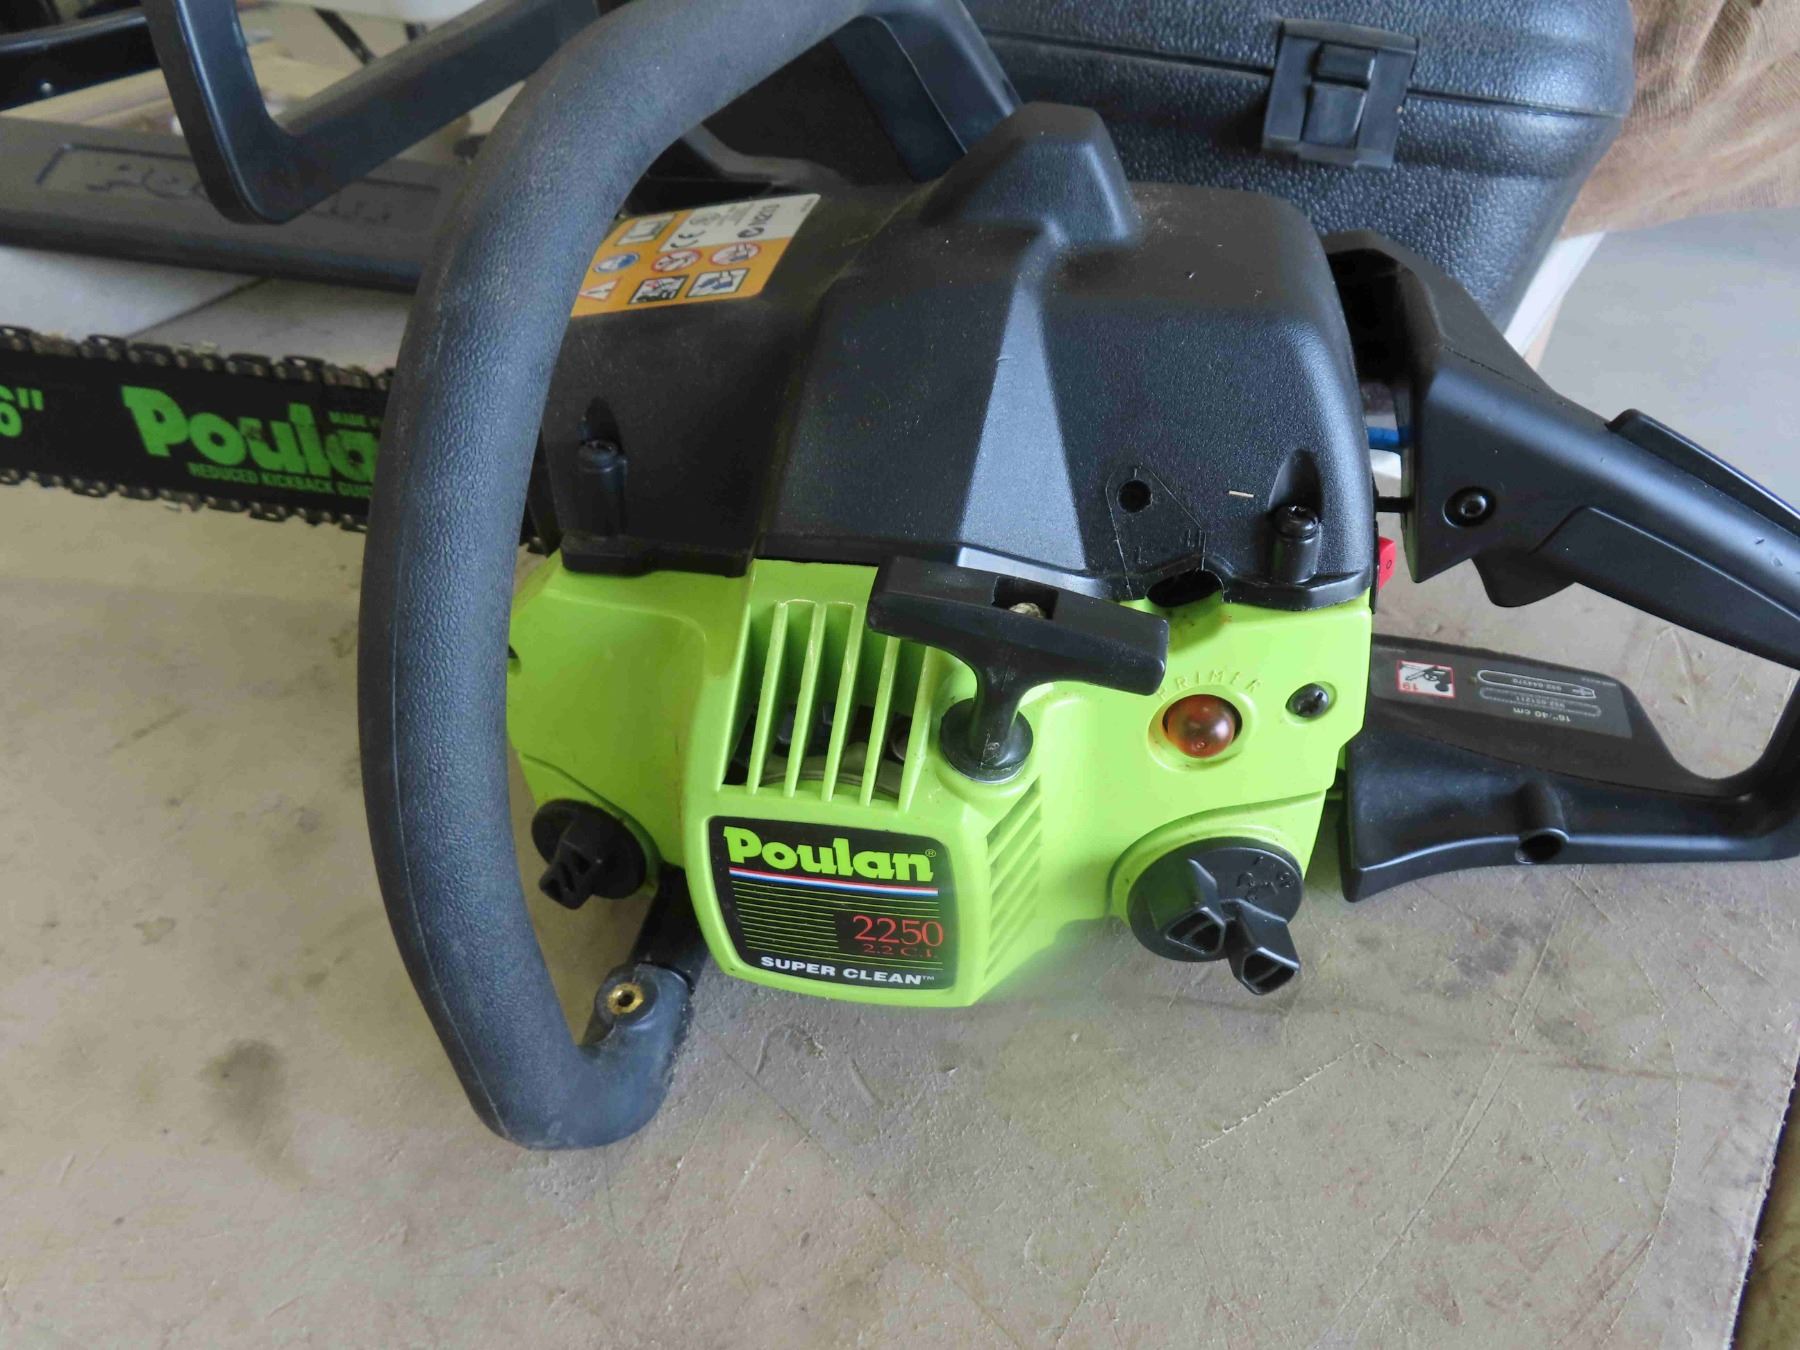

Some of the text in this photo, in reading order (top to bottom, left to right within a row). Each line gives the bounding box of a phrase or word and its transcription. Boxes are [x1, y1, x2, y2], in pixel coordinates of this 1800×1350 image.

[187, 462, 259, 484] REDUCED
[261, 471, 336, 495] KICKBACK
[1156, 669, 1263, 702] PRIMER
[852, 914, 944, 947] 2250
[760, 956, 837, 977] SUPER
[863, 943, 894, 957] 2.2
